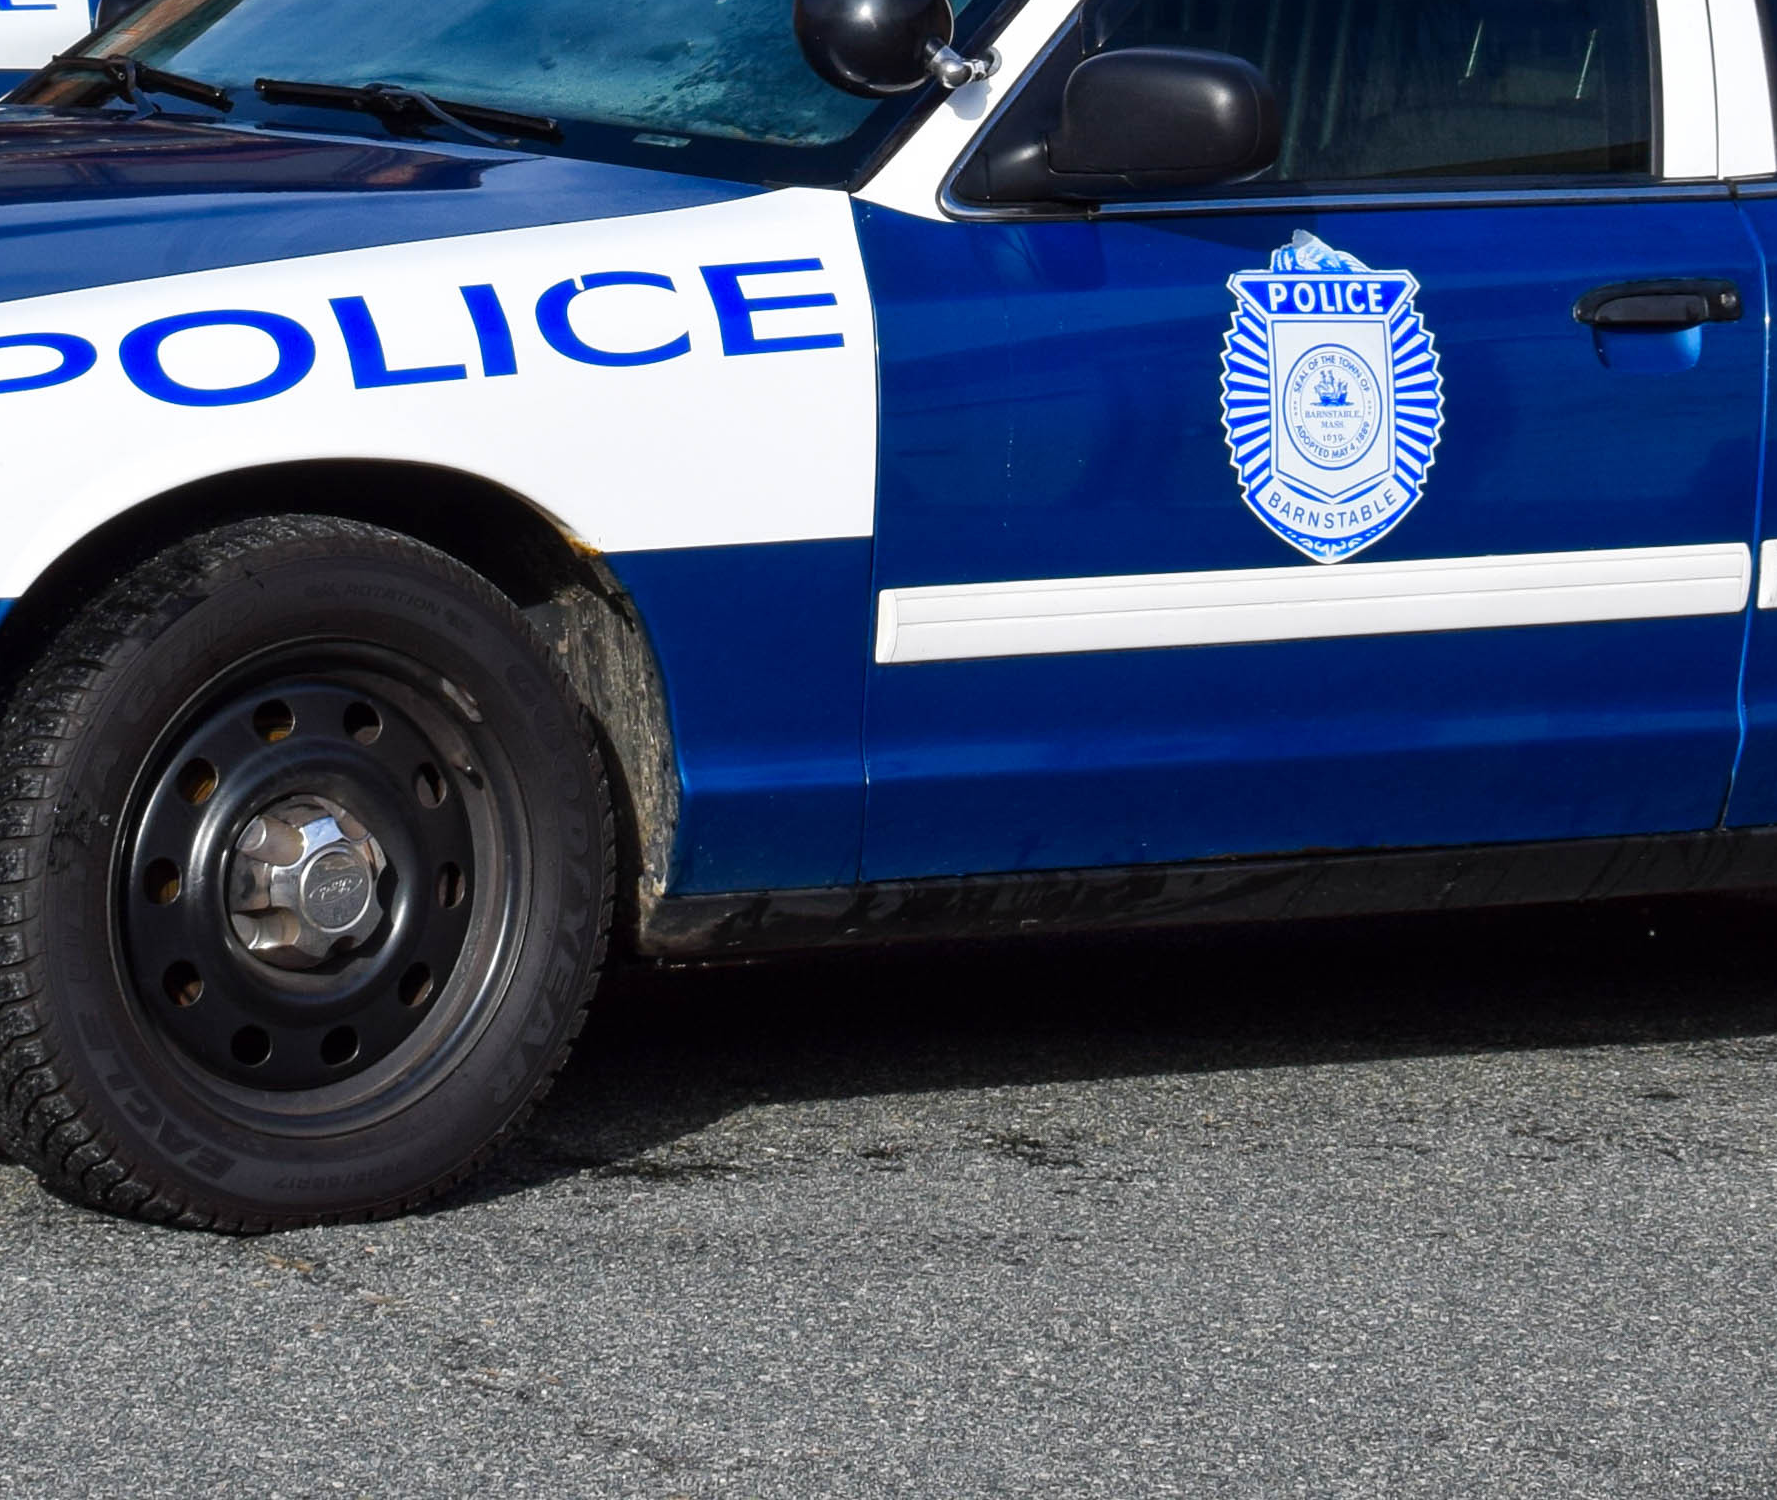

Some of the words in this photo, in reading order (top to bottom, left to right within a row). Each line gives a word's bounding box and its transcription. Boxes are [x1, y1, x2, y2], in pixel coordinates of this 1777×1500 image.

[1267, 281, 1385, 313] POLICE
[1294, 370, 1309, 393] SEAL
[1308, 358, 1319, 371] OF
[1320, 355, 1336, 364] THE
[1339, 356, 1363, 379] TOWN
[1296, 425, 1330, 458] ADOPTED
[1268, 488, 1397, 530] BARNSTABLE
